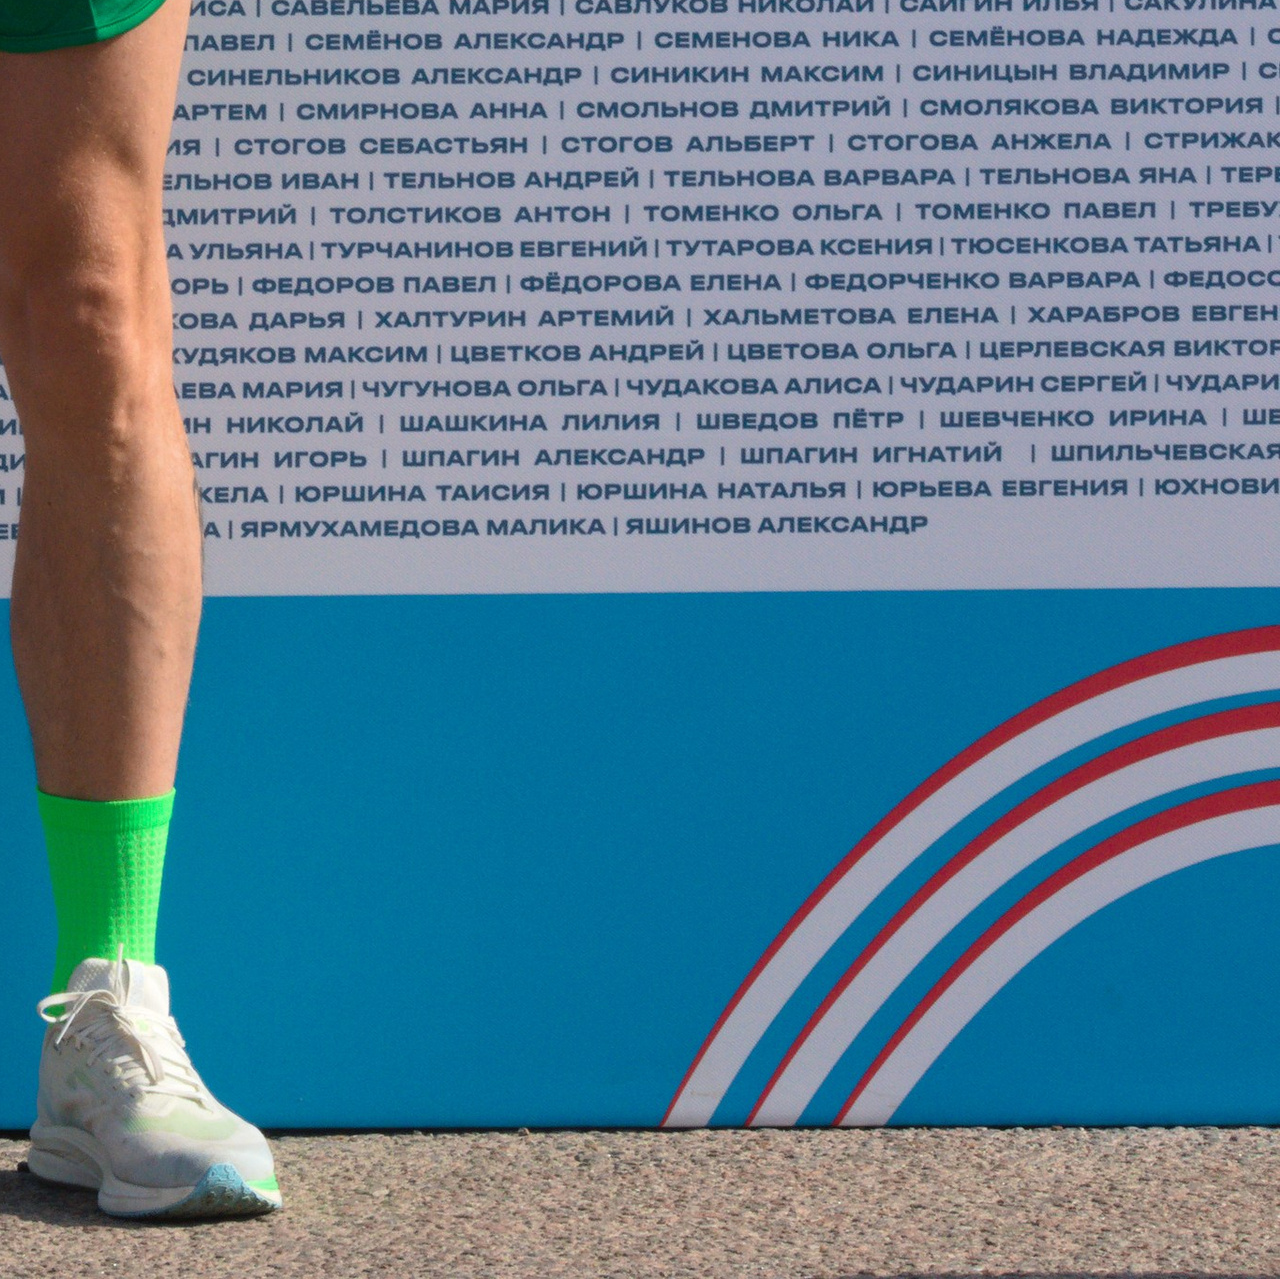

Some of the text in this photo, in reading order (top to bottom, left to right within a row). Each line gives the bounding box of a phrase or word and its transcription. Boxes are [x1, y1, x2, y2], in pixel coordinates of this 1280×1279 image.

[655, 31, 899, 48] СЕМЕНОВА НИКА
[577, 96, 890, 119] СМОЛЬНОВ ДМИТРИЙ
[664, 169, 955, 187] ТЕЛЬНОВА ВАРВАРА
[666, 238, 932, 256] ТУТАРОВА КСЕНИЯ
[520, 272, 681, 294] ФЁДОРОВА
[691, 274, 781, 291] ЕЛЕНА
[704, 307, 999, 325] ХАЛЬМЕТОВА ЕЛЕНА
[627, 378, 881, 397] ЧУДАКОВА АЛИСА
[697, 413, 818, 431] ШВЕДОВ
[834, 408, 904, 428] ПЁТР
[741, 442, 1002, 464] ШПАГИН ИГНАТИЙ
[626, 517, 751, 534] ЯШИНОВ
[758, 516, 928, 534] АЛЕКСАНДР
